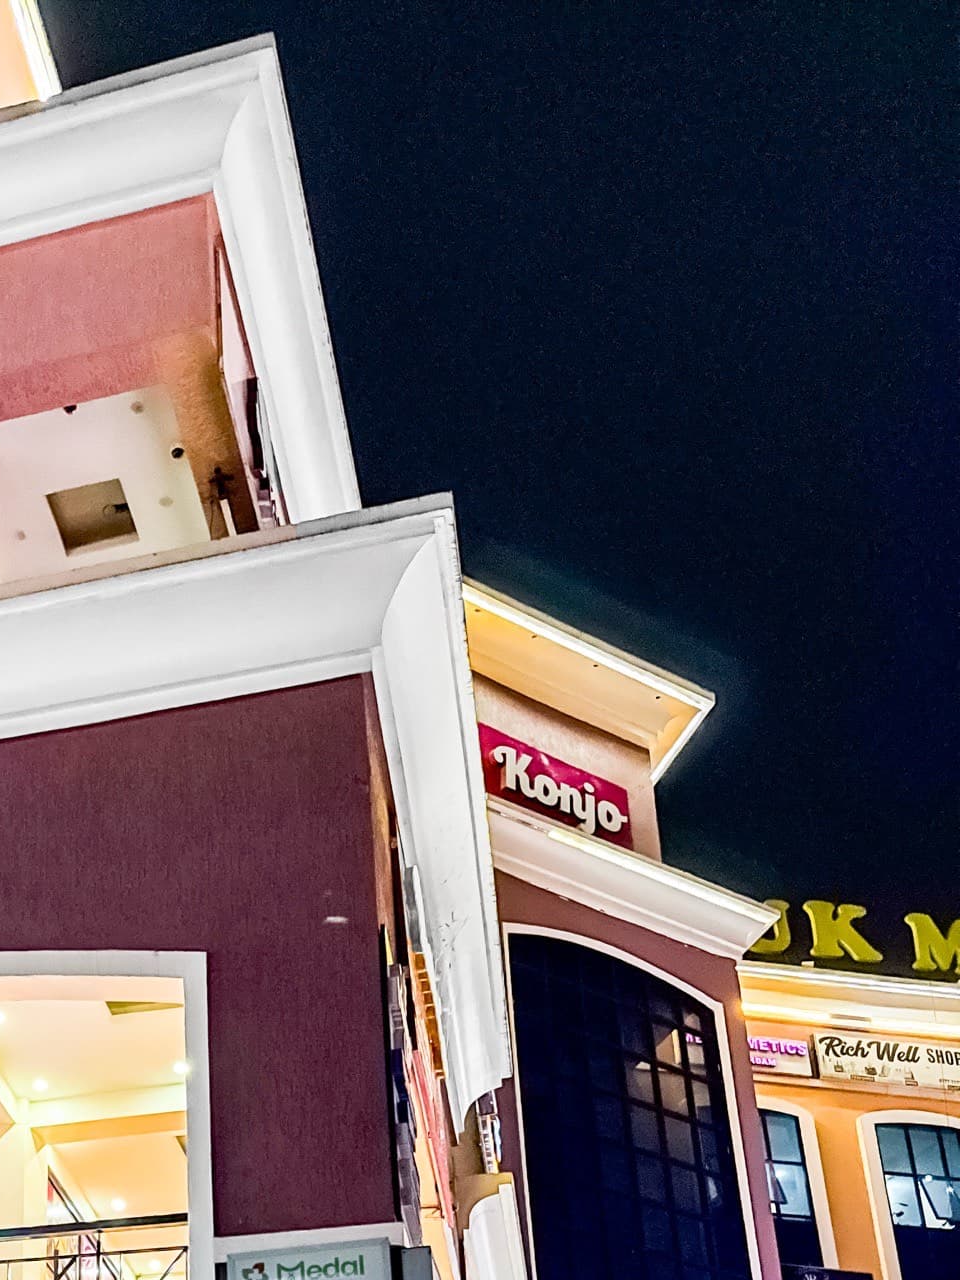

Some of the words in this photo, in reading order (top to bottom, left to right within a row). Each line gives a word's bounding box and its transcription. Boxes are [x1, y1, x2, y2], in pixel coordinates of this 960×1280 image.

[493, 746, 628, 834] Konjo
[818, 1036, 870, 1059] Rich
[868, 1041, 920, 1063] Well
